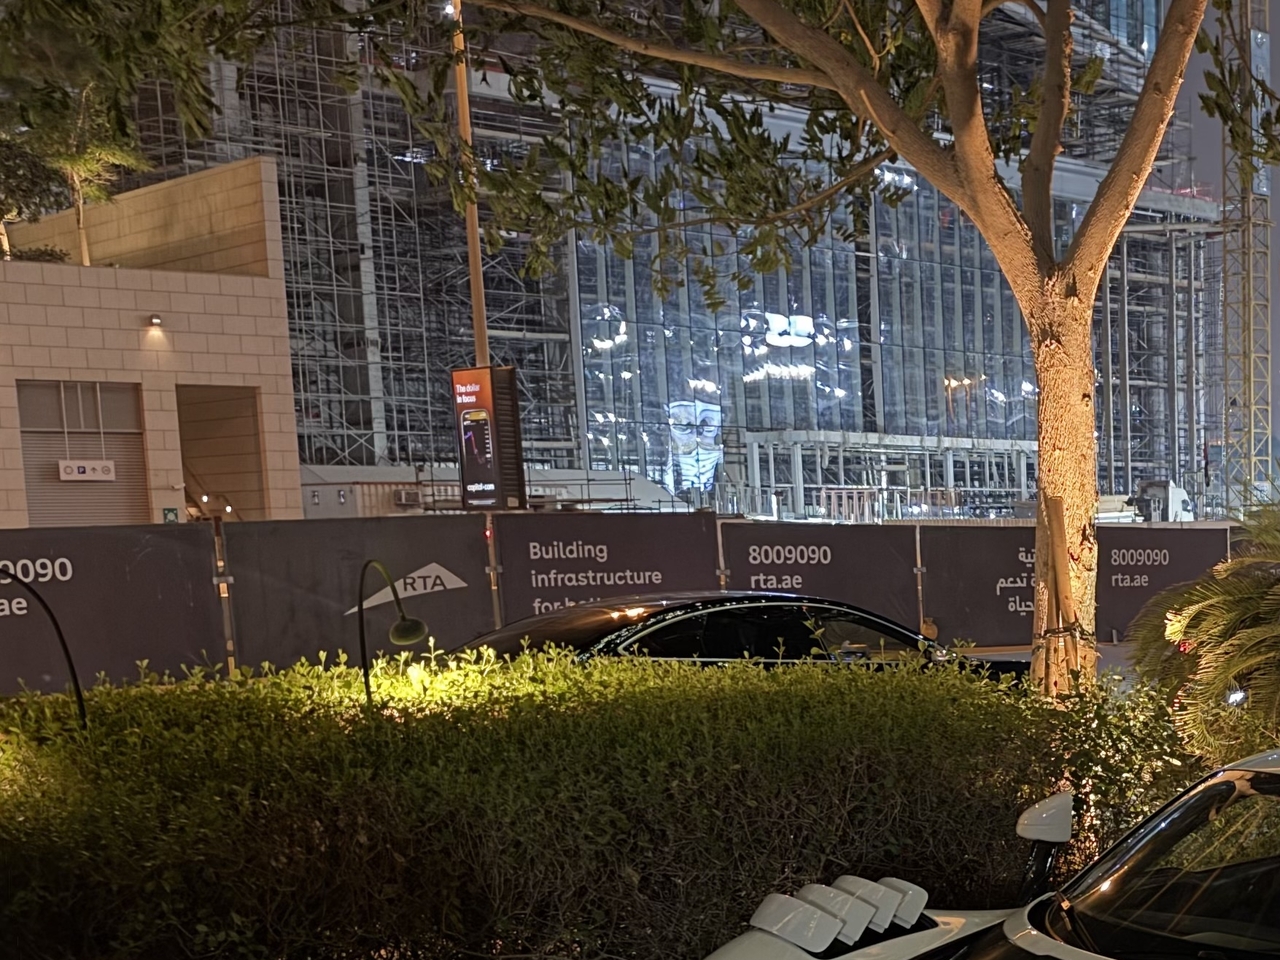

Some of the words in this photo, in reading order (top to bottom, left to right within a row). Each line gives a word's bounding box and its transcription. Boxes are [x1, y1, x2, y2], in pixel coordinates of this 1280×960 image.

[529, 541, 608, 562] Building
[748, 545, 831, 564] 8009090
[1111, 549, 1169, 565] 8009090
[403, 575, 447, 592] RTA
[531, 569, 662, 588] infrastructure
[750, 573, 802, 589] rta.ae
[996, 573, 1027, 596] تدعم
[1111, 573, 1149, 587] rta.ae
